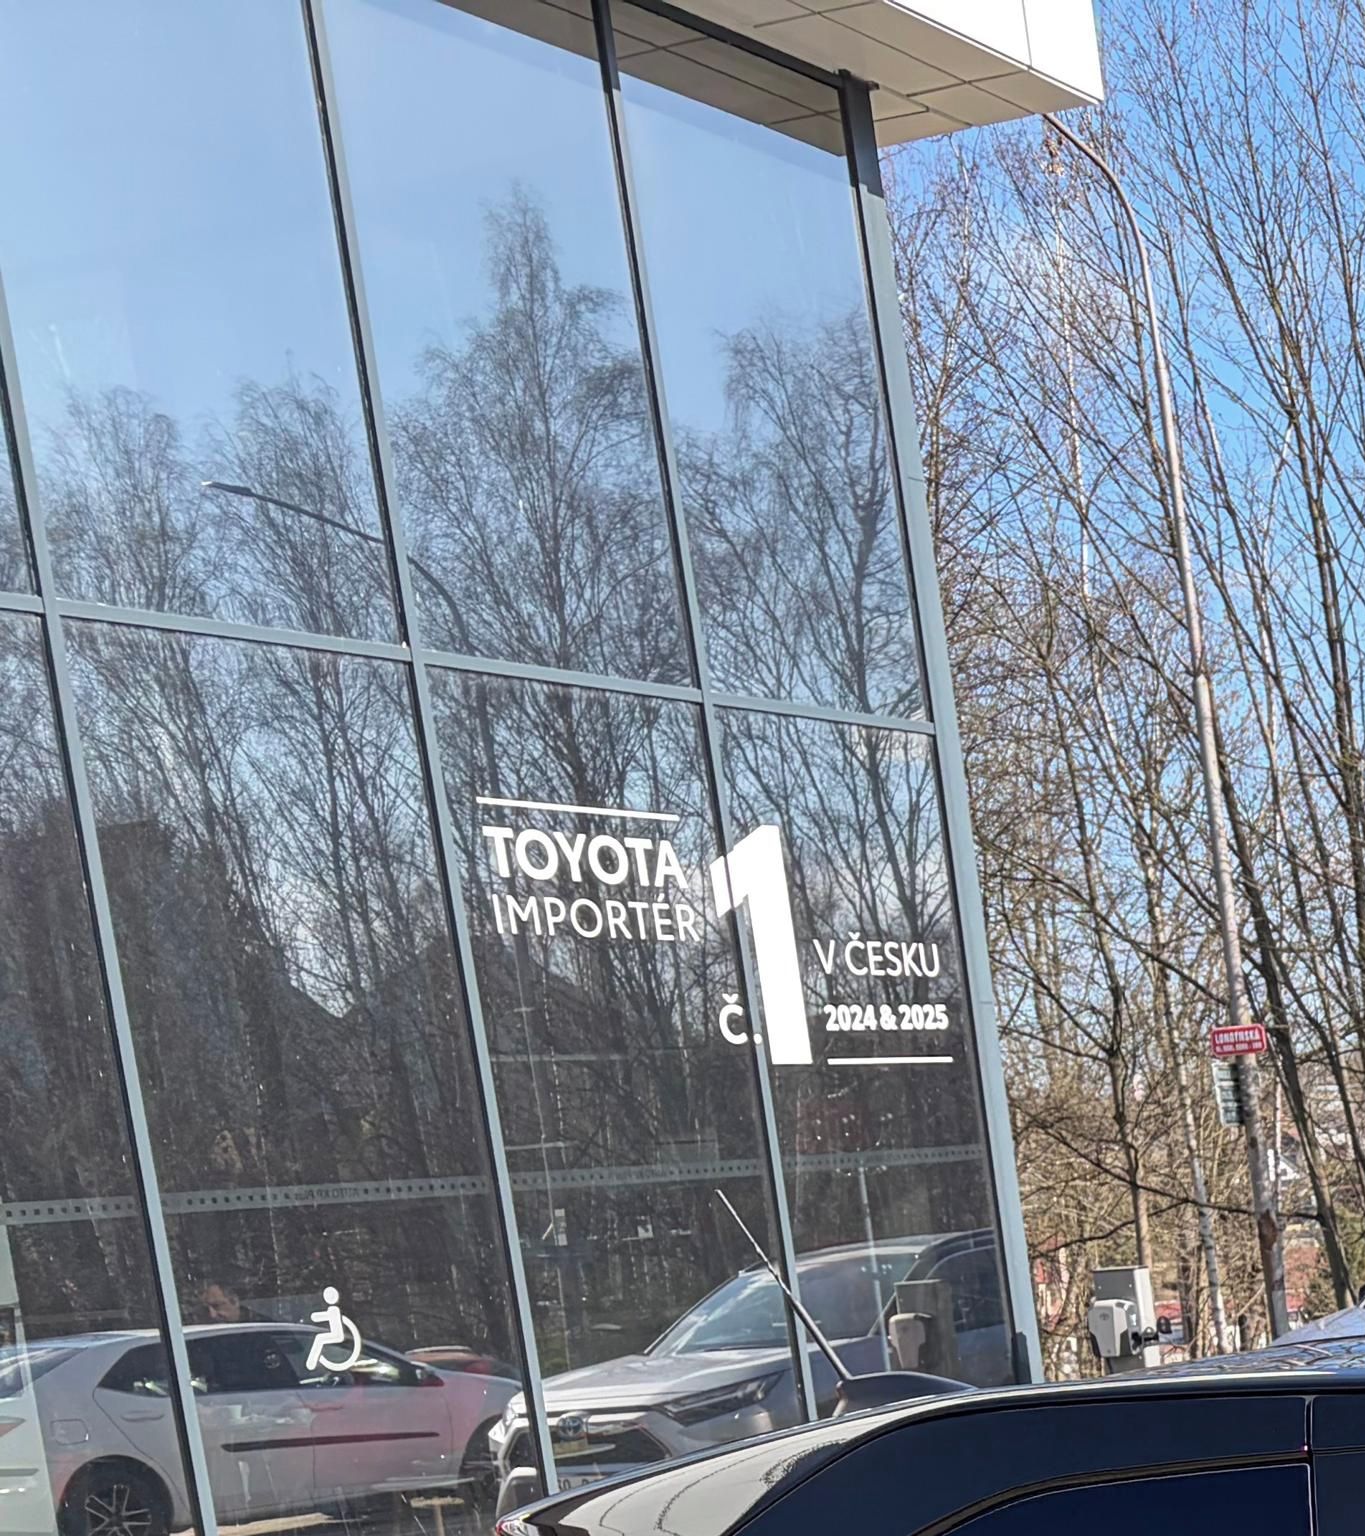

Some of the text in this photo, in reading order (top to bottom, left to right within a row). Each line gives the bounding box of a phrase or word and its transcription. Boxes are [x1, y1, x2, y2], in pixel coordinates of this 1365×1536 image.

[482, 825, 689, 890] TOYOTA
[491, 892, 701, 942] IMPORTÉR
[709, 824, 814, 1065] 1
[813, 931, 940, 978] V ČESKU
[824, 1003, 950, 1032] 2024 & 2025
